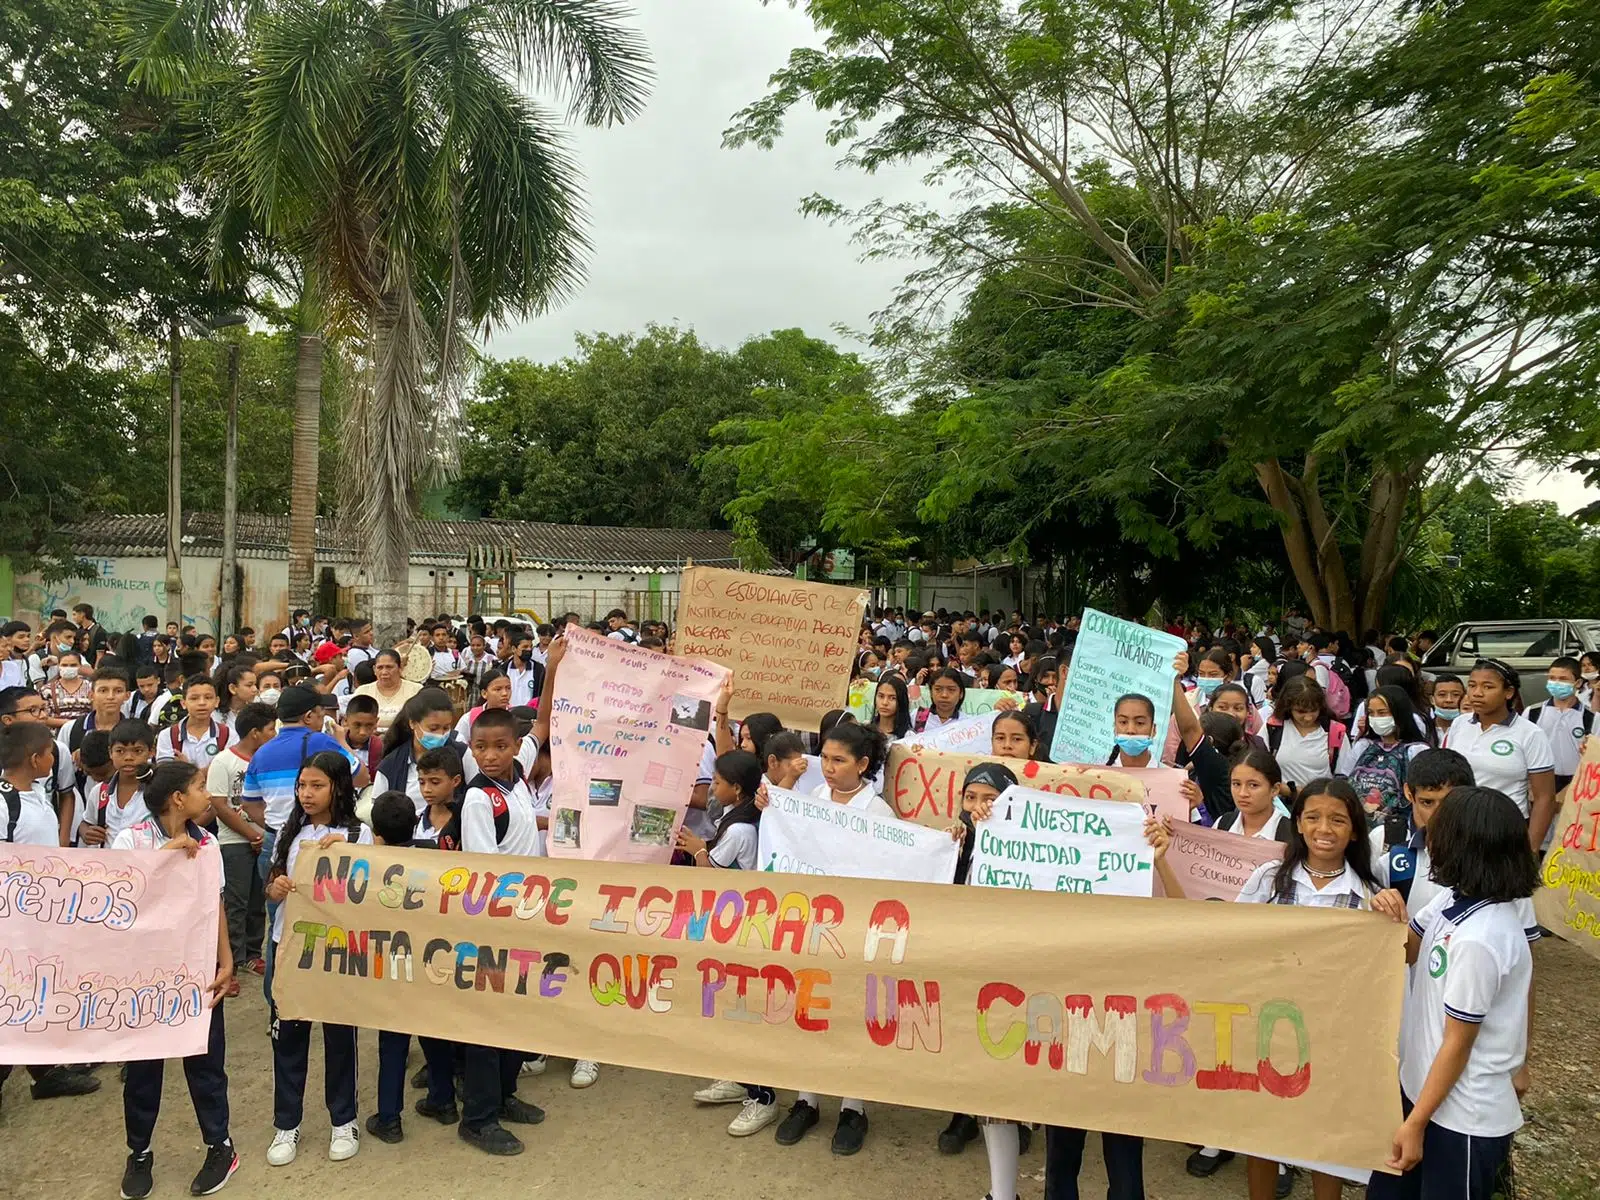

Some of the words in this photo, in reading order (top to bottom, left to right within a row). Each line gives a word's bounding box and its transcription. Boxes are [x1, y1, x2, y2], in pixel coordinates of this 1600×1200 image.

[691, 570, 716, 598] LOS
[725, 581, 818, 611] ESTUDIANTES
[751, 613, 807, 632] EDUCATIVA
[1087, 612, 1153, 649] COMUNICADO
[739, 649, 756, 662] DE
[762, 656, 820, 673] NUESTRO
[808, 641, 820, 655] LA
[1111, 640, 1164, 673] INCANISTA
[741, 670, 793, 685] COMEDOR
[801, 677, 830, 691] PARA
[784, 796, 800, 815] CON
[850, 815, 868, 834] CON
[873, 821, 915, 847] PALABRAS
[980, 829, 1082, 865] COMUNIDAD
[977, 864, 1034, 890] CATIVA
[313, 855, 371, 905] NO
[378, 863, 426, 911] SE
[438, 866, 578, 926] PUEDE
[589, 884, 847, 960] IGNORAR
[863, 899, 911, 965] A
[293, 920, 414, 984] TANTA
[422, 938, 570, 998] GENTE
[588, 953, 679, 1014] QUE
[696, 958, 833, 1032] PIDE
[865, 973, 943, 1054] UN
[976, 982, 1312, 1098] CAMBIO
